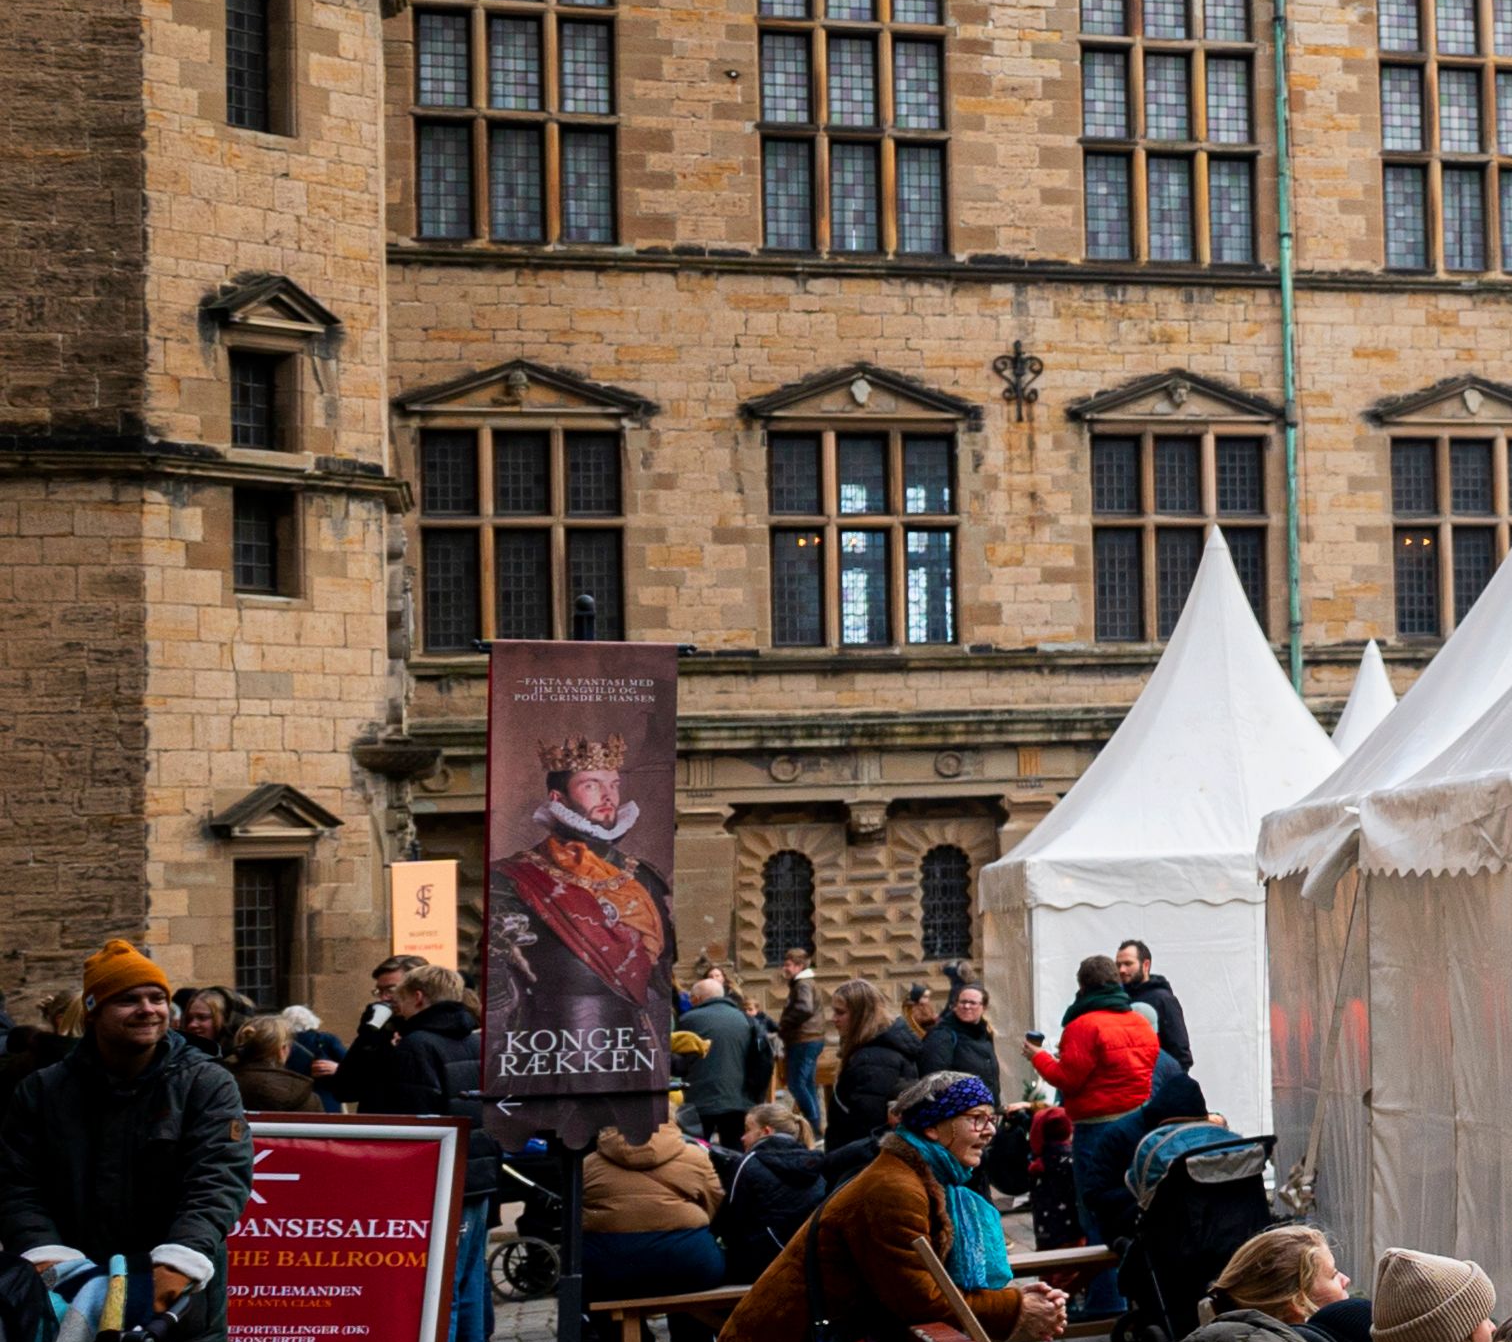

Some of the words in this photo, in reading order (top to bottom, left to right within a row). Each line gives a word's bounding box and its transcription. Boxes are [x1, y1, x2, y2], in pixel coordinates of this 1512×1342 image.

[578, 678, 625, 687] FANTASI
[629, 679, 654, 687] MED
[534, 686, 555, 695] JIM
[557, 686, 615, 694] LYNGVILD
[514, 693, 544, 701] POUL
[505, 1027, 651, 1054] KONGE-
[498, 1048, 659, 1077] RÆKKEN
[228, 1250, 270, 1267] HE
[276, 1251, 427, 1268] BALLROOM
[227, 1285, 250, 1296] ØD
[251, 1285, 363, 1298] JULEMANDEN
[247, 1299, 288, 1307] SANTA
[291, 1299, 331, 1307] CLAUS
[227, 1325, 339, 1334] EFORTÆLLINGER
[342, 1325, 370, 1335] (DK)
